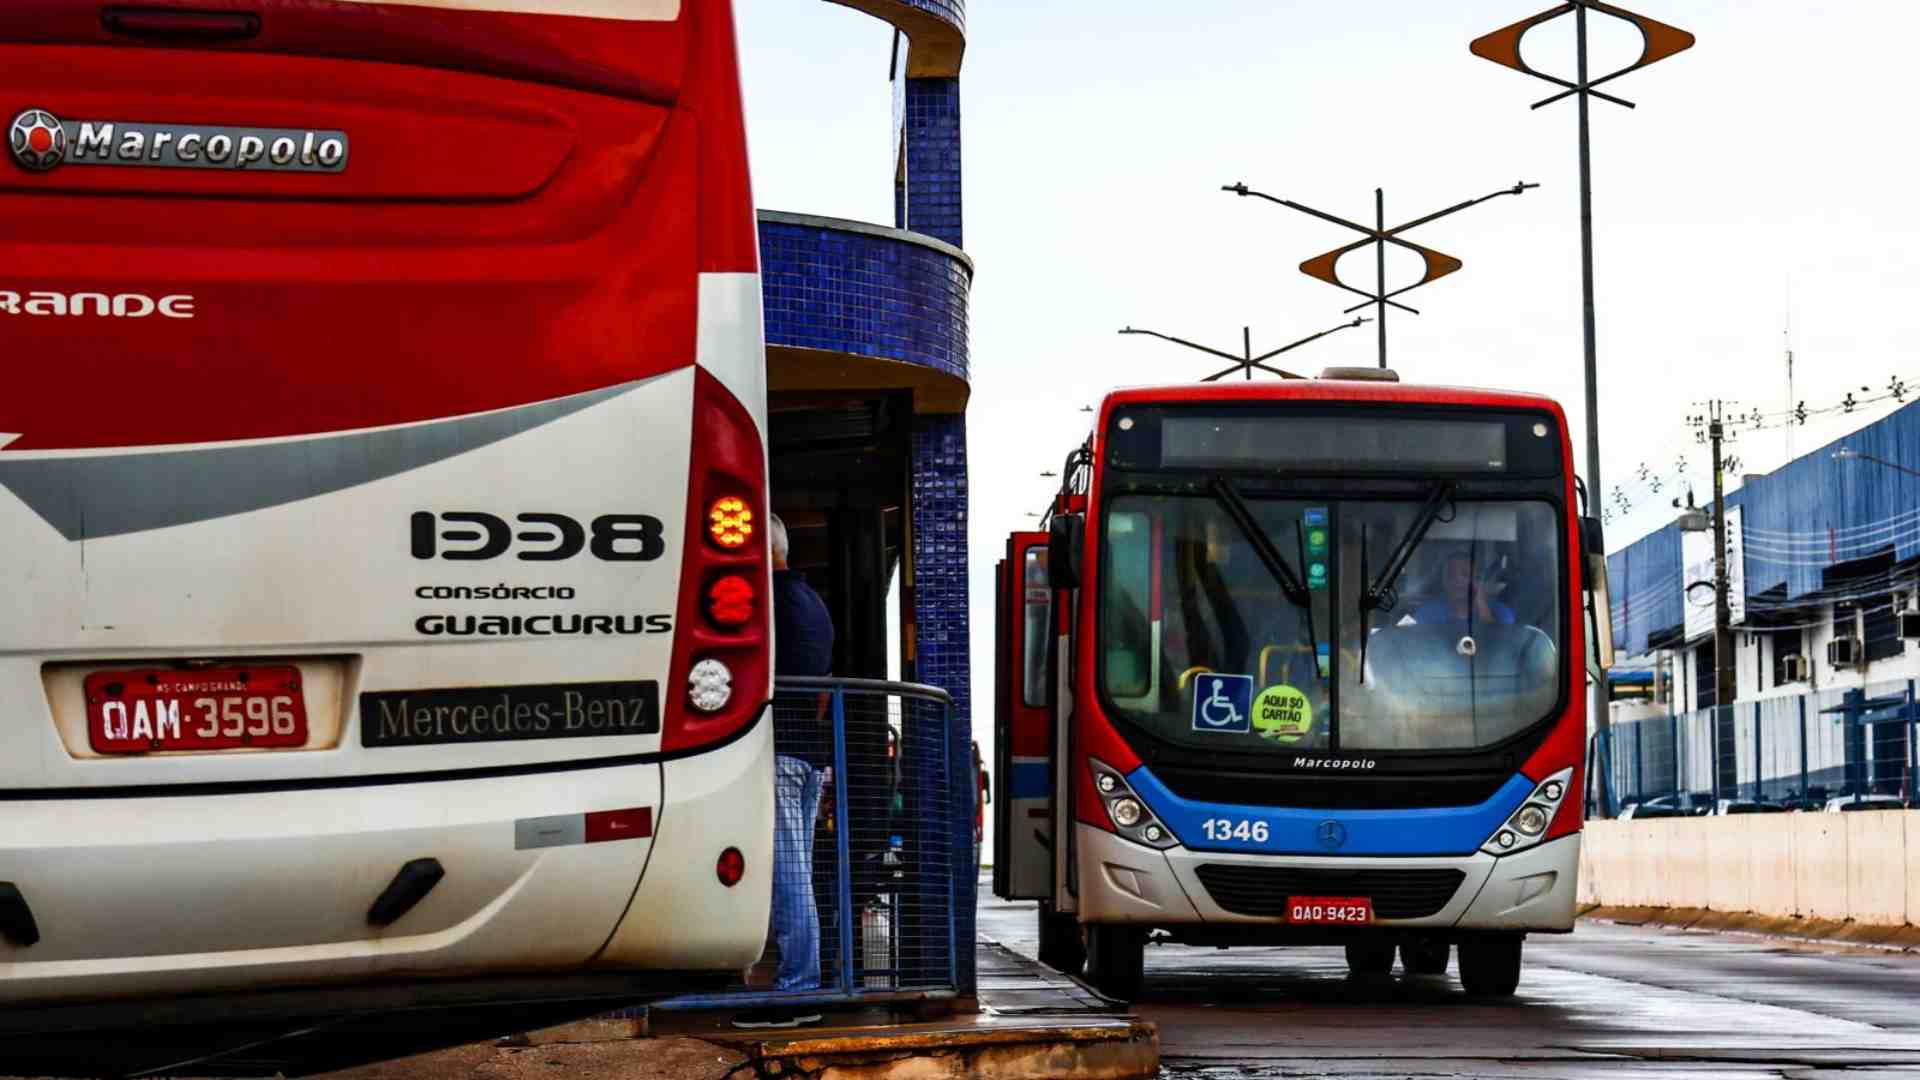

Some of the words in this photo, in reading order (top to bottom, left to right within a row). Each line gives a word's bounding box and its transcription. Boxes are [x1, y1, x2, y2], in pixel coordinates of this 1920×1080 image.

[74, 122, 345, 167] Marcopolo
[410, 510, 665, 561] 1338
[414, 614, 673, 636] GUAICURUS
[1263, 695, 1288, 707] AQUI
[376, 690, 647, 739] Mercedes-Benz
[1293, 757, 1376, 769] Marcopolo
[1202, 819, 1269, 842] 1346
